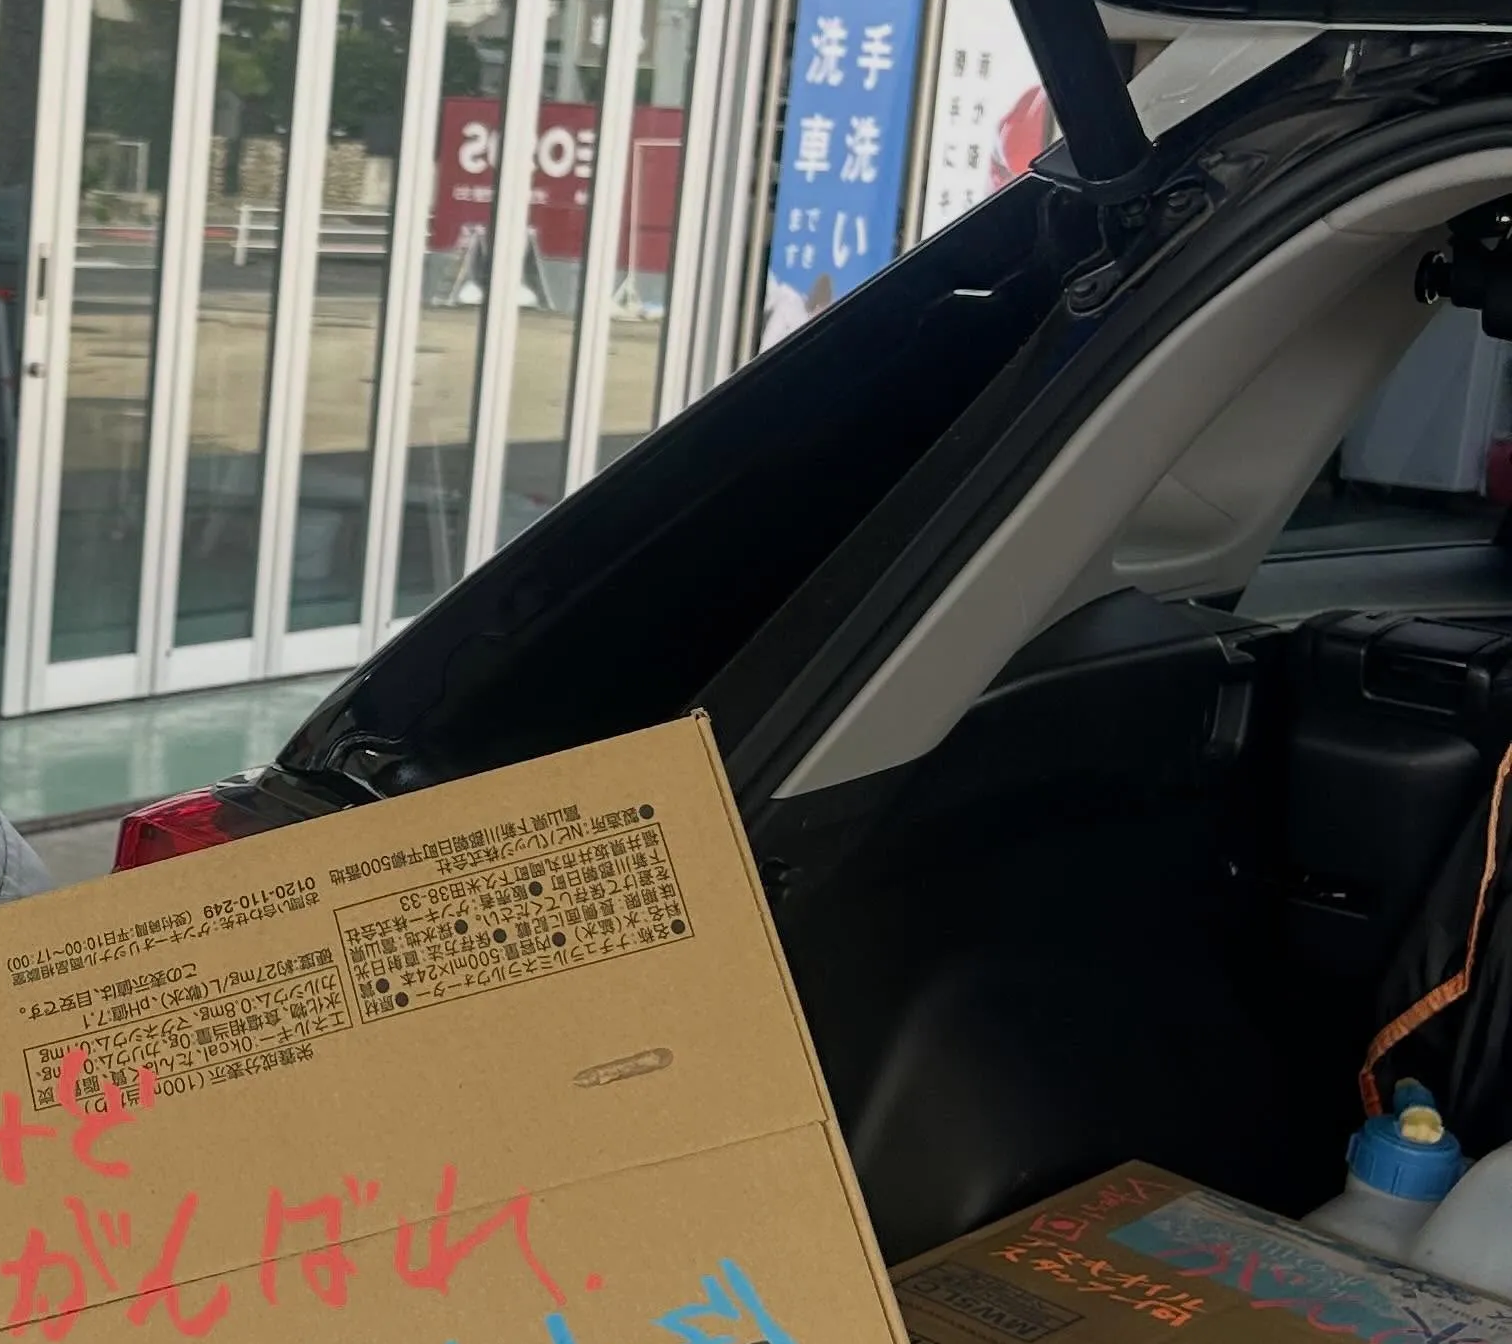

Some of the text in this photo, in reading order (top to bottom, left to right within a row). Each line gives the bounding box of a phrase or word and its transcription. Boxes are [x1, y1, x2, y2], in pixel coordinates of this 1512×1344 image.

[793, 16, 848, 184] 洗車
[832, 23, 894, 269] 手洗い
[201, 877, 316, 919] 0120-110-249
